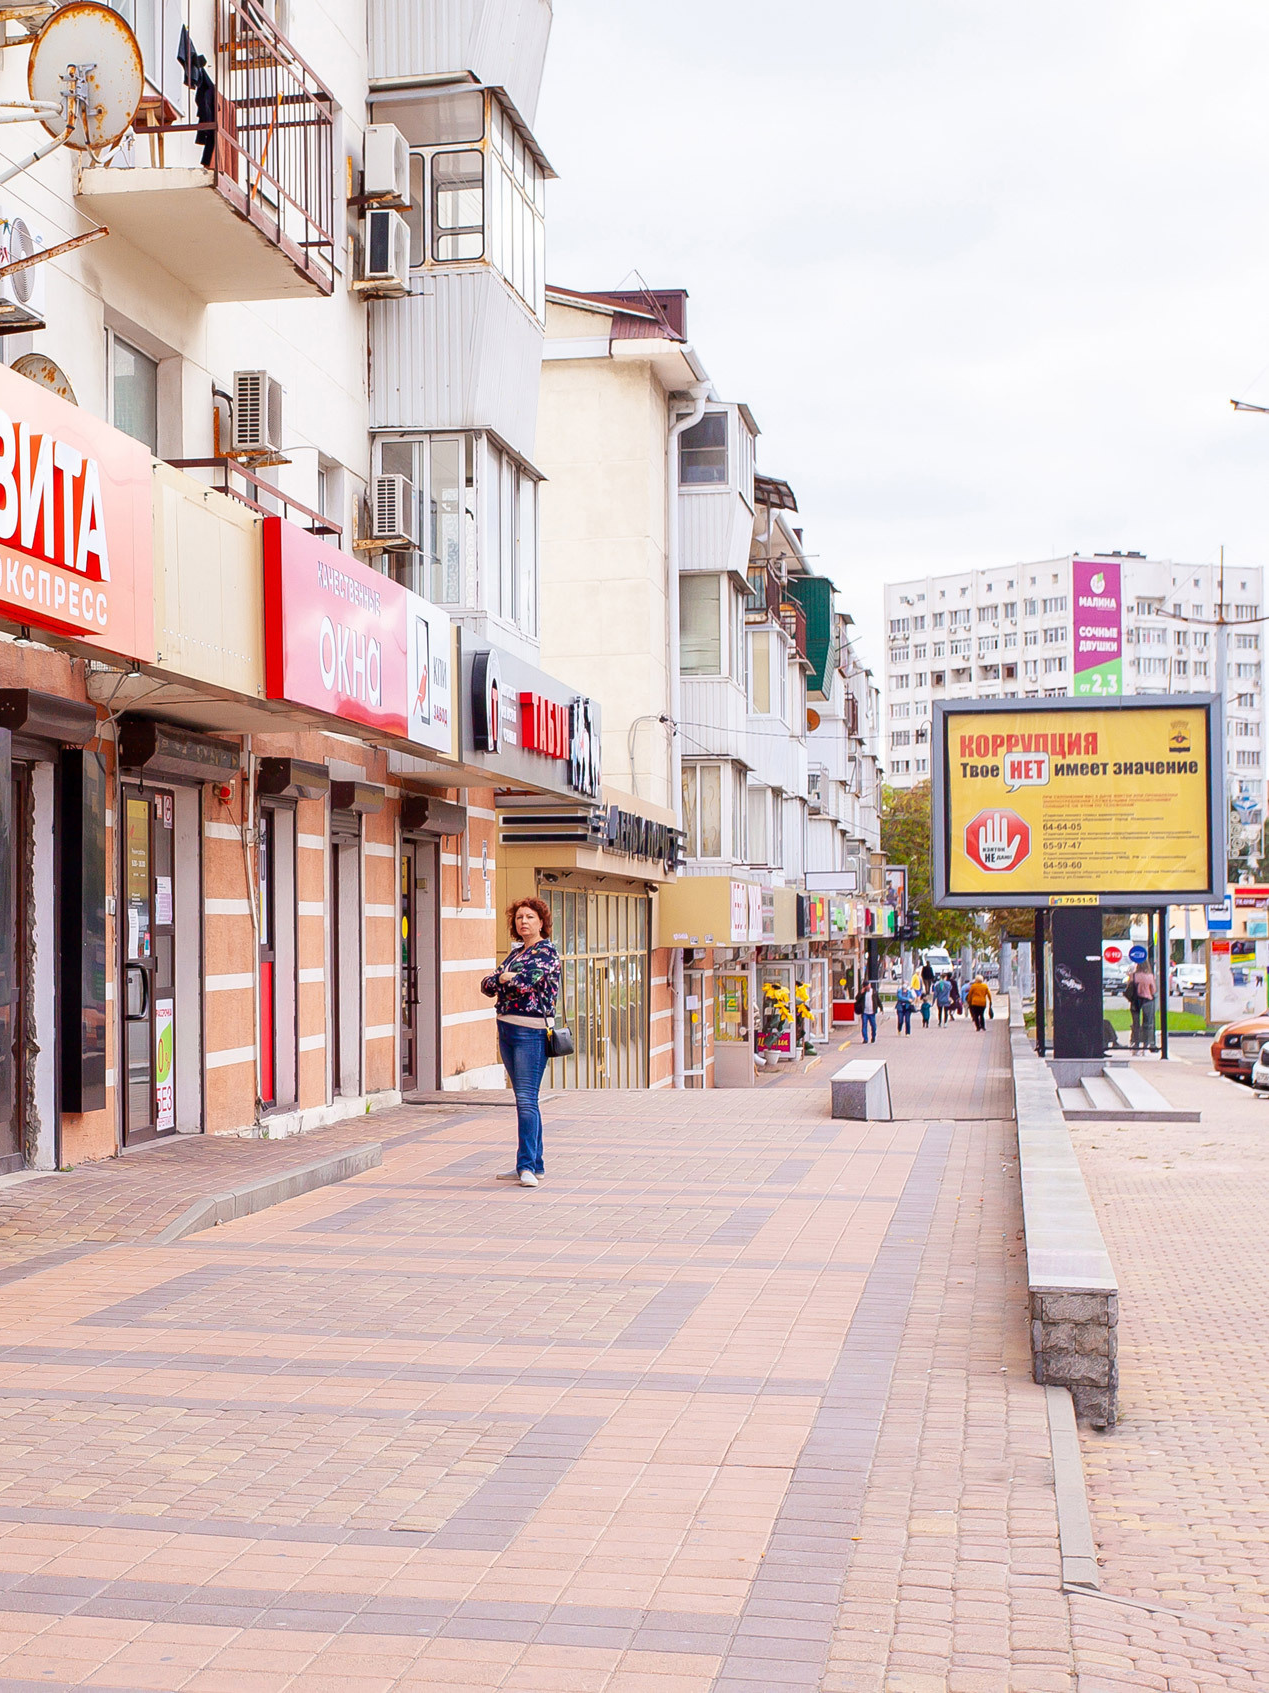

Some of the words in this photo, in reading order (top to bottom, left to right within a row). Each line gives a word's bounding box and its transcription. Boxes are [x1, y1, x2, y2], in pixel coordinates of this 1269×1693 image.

[317, 560, 381, 617] КАЧЕСТВЕННЫЕ
[1078, 596, 1117, 608] МАЛИНА
[1078, 626, 1118, 638] СОЧНЫЕ
[1078, 640, 1118, 652] ДВУШКИ
[526, 691, 570, 760] ТАБУН
[959, 732, 1098, 759] КОРРУПЦИЯ
[960, 762, 1000, 778] Твое
[1009, 760, 1046, 780] НЕТ
[1054, 761, 1109, 777] имеет
[1113, 760, 1199, 776] значение
[1042, 823, 1082, 831] 64-64-05
[1042, 842, 1082, 850] 65-97-47
[984, 853, 995, 863] НЕ
[1043, 861, 1082, 869] 64-59-60
